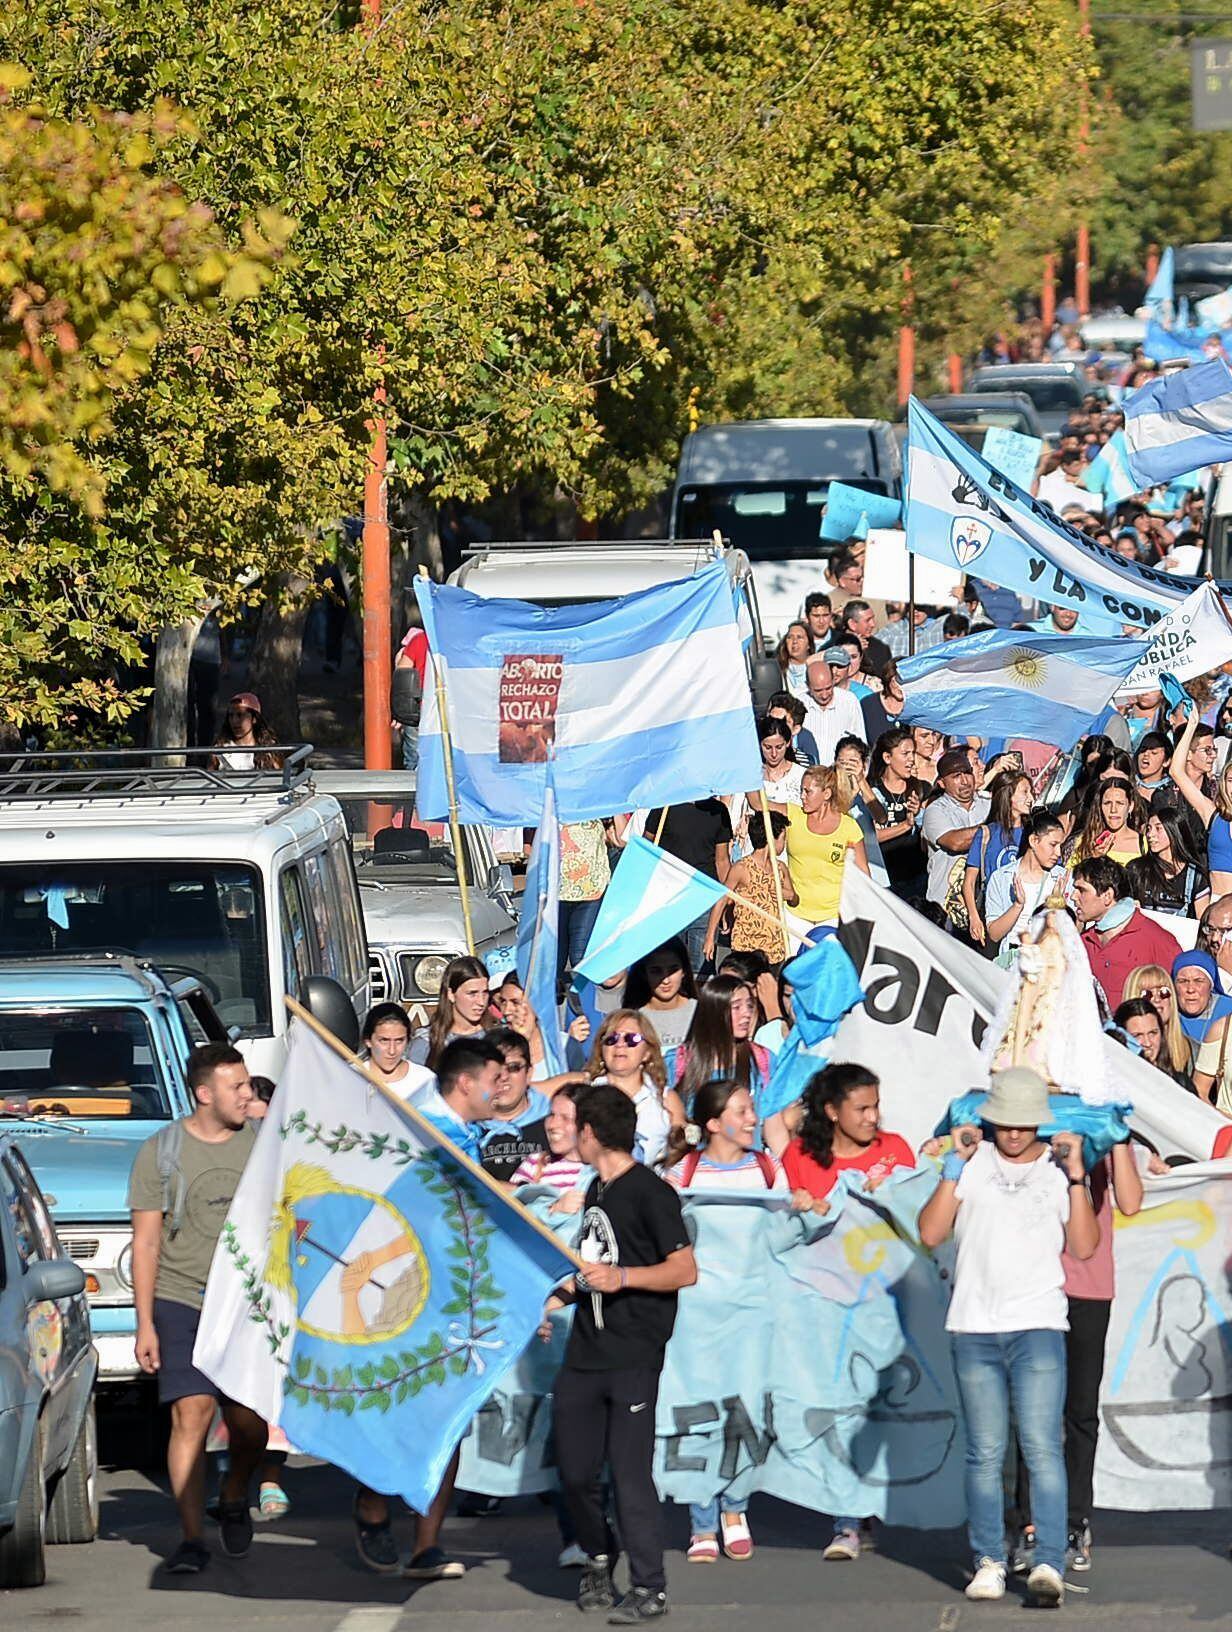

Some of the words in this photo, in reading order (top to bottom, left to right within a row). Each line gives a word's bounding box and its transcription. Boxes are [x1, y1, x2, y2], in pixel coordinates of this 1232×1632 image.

[1028, 557, 1047, 583] Y
[1052, 567, 1087, 602] LA
[501, 683, 558, 697] RECHAZO
[500, 700, 551, 721] TOTAL
